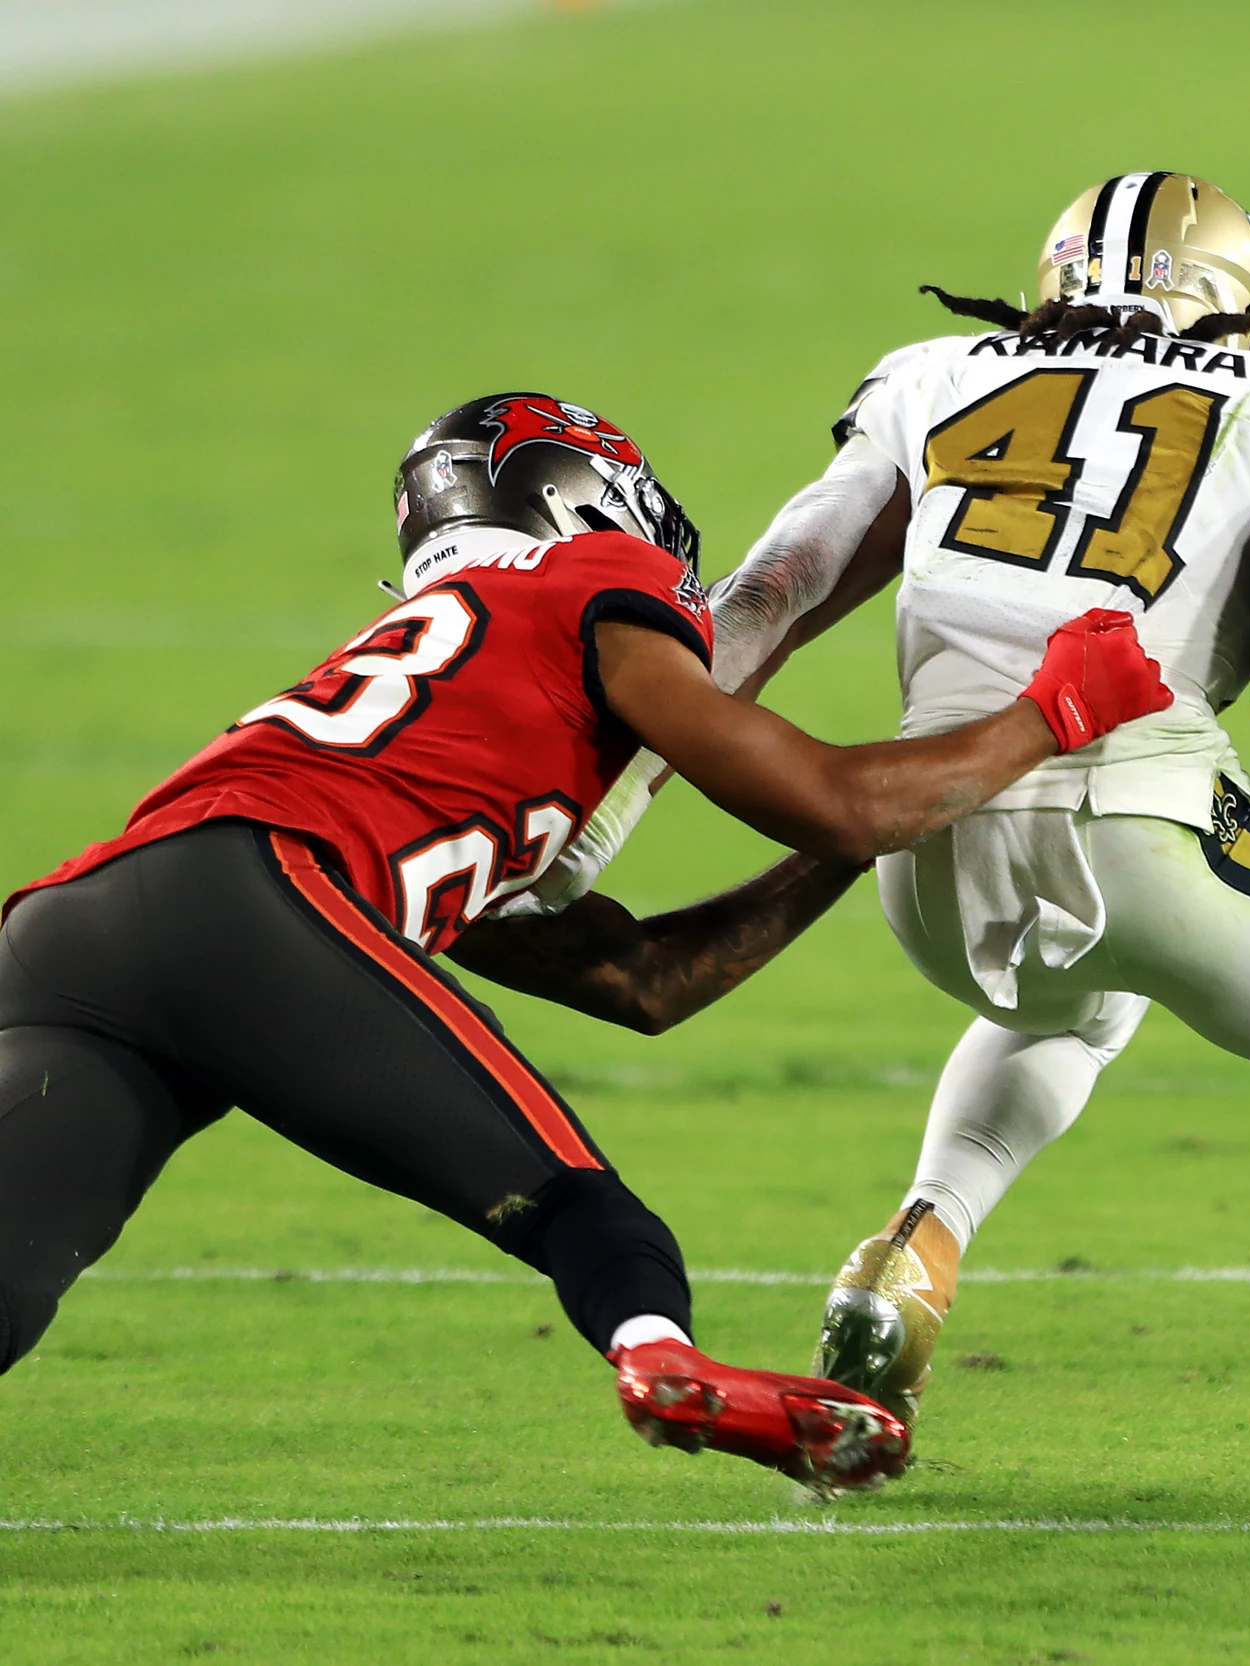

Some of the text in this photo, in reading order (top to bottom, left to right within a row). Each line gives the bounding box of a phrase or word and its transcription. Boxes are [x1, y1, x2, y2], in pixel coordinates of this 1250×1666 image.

[968, 331, 1246, 379] KAMARA
[922, 367, 1230, 612] 41
[415, 558, 432, 578] STOP
[434, 545, 458, 564] HATE
